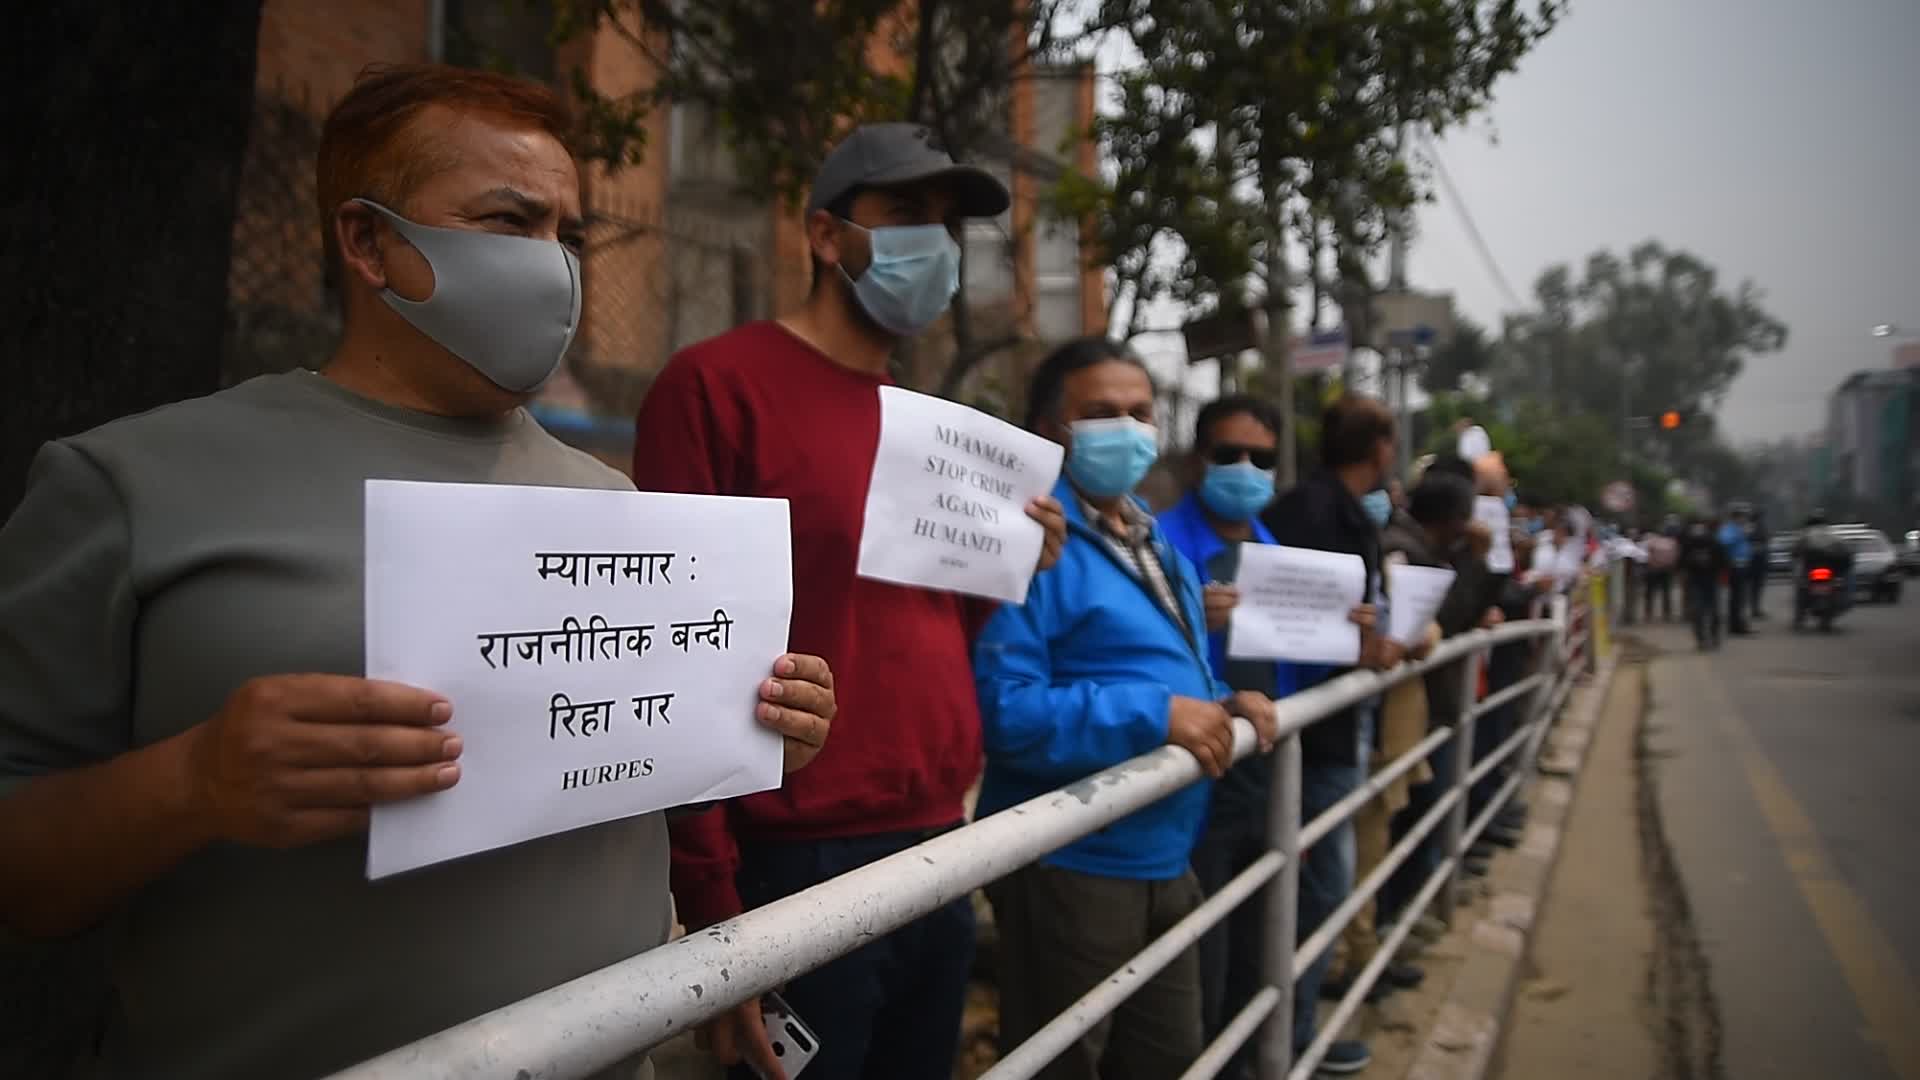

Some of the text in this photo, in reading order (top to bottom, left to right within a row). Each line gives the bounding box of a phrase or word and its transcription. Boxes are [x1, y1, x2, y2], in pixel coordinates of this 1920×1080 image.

[924, 455, 1016, 500] STOP CRIME
[933, 492, 1001, 525] AGAINST
[914, 517, 1007, 555] HUMANITY
[535, 552, 676, 586] म्यानमार
[477, 608, 734, 670] राजनीतिक बन्दी
[548, 692, 675, 740] रिहा गर
[561, 758, 655, 791] HURPES
